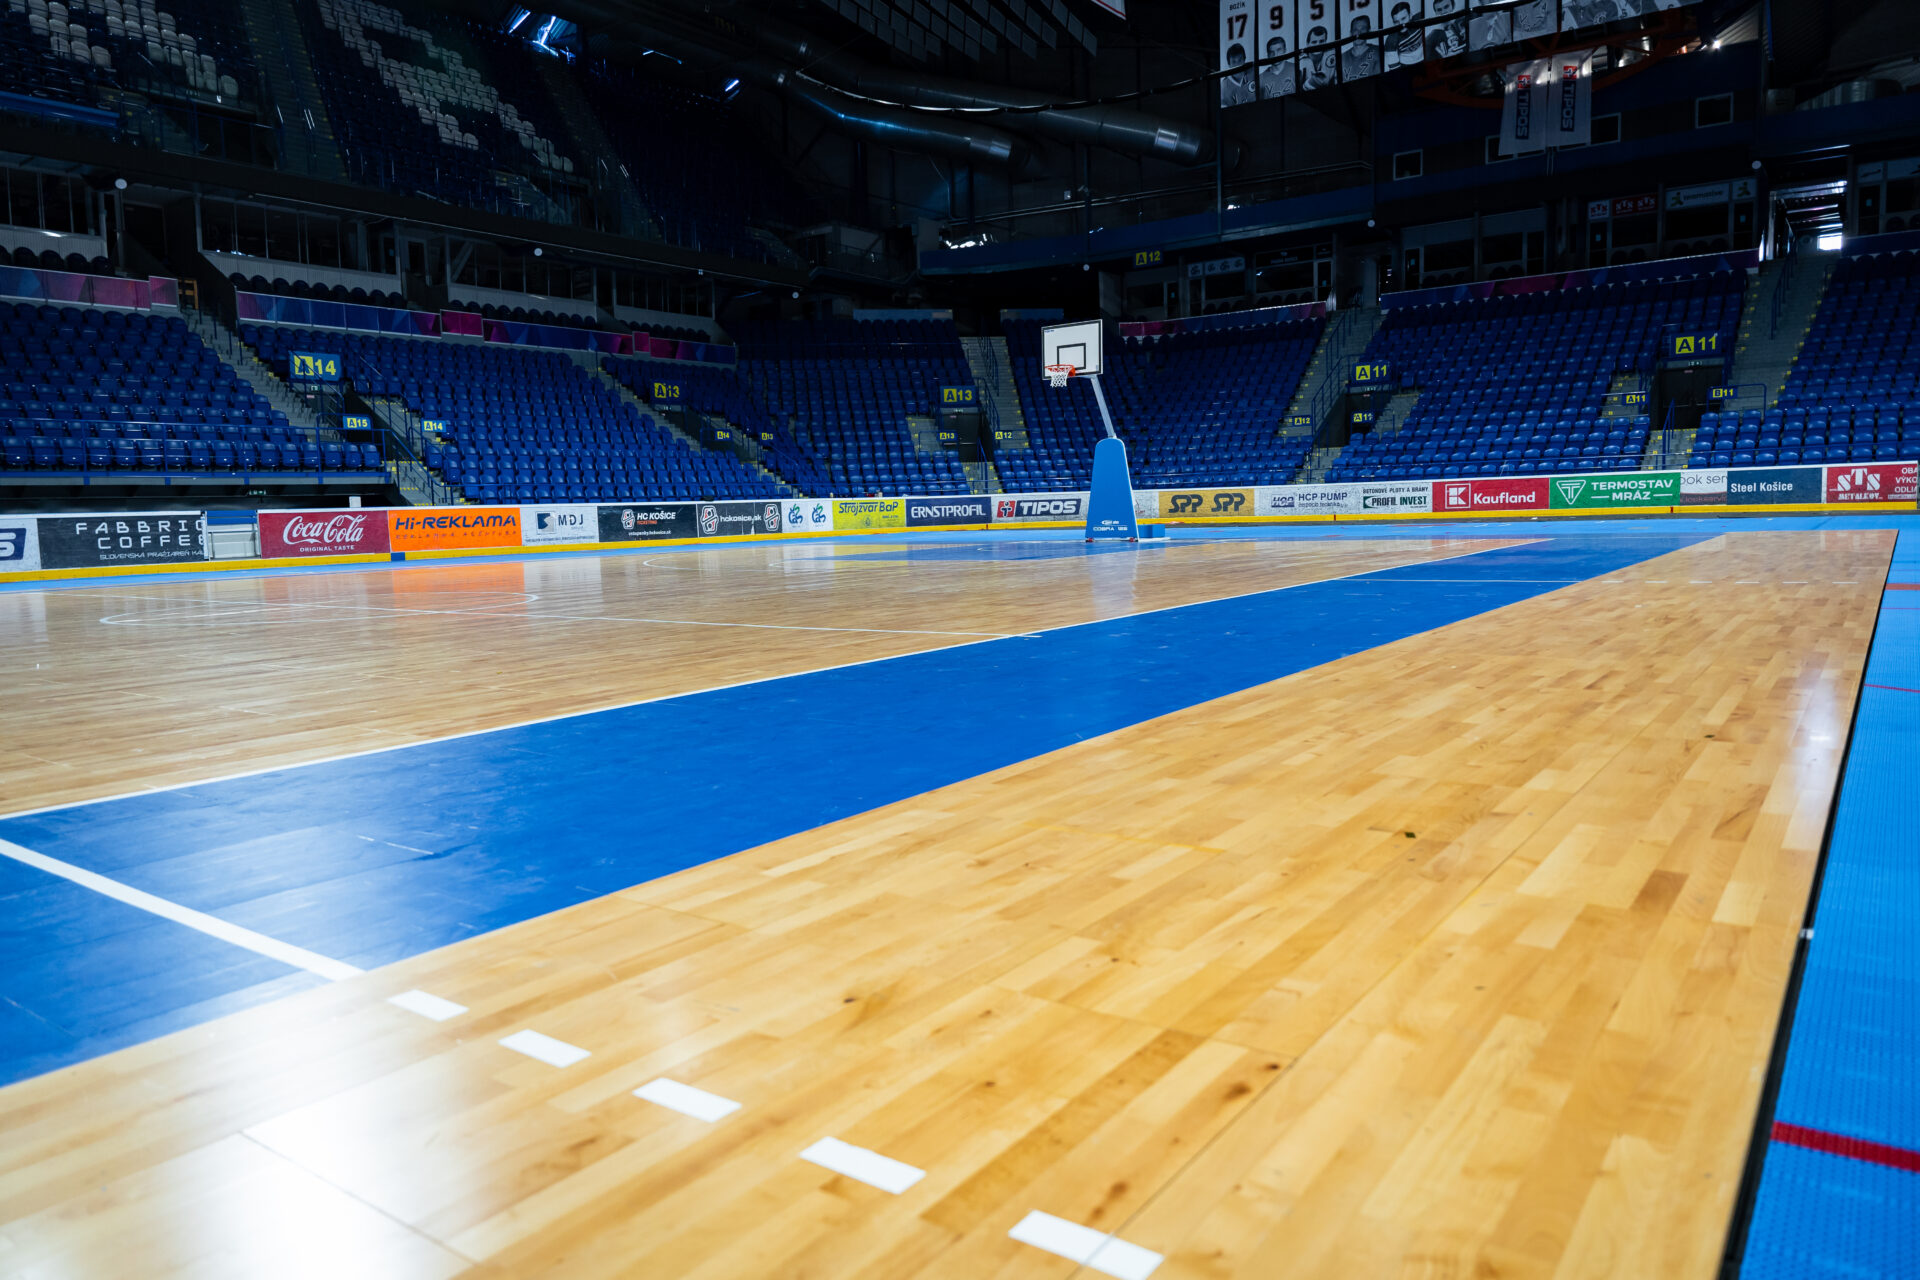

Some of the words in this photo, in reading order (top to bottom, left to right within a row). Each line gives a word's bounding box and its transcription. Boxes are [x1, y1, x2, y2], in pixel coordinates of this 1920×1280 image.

[1270, 6, 1283, 29] 9
[1228, 14, 1247, 39] 17
[1563, 82, 1575, 130] TIPOS
[1518, 91, 1529, 137] TIPOS
[1591, 480, 1673, 491] TERMOSTAV
[1730, 482, 1757, 493] Steel
[1760, 481, 1793, 491] Košice
[1837, 468, 1881, 491] STS
[1211, 493, 1246, 512] SPP
[1298, 493, 1318, 501] HCP
[1320, 492, 1348, 501] PUMP
[1371, 497, 1397, 506] PROFIL
[1400, 496, 1427, 505] INVEST
[1473, 491, 1536, 504] Kaufland
[1612, 490, 1651, 501] MRÁZ
[839, 502, 878, 516] Strojzvar
[879, 501, 899, 512] BaP
[1020, 501, 1077, 515] TIPOS
[1168, 494, 1203, 513] SPP
[649, 511, 676, 520] KOŠICE
[911, 504, 986, 519] ERNSTPROFIL
[283, 514, 367, 545] Coca-Cola
[395, 515, 516, 530] Hi-REKLAMA
